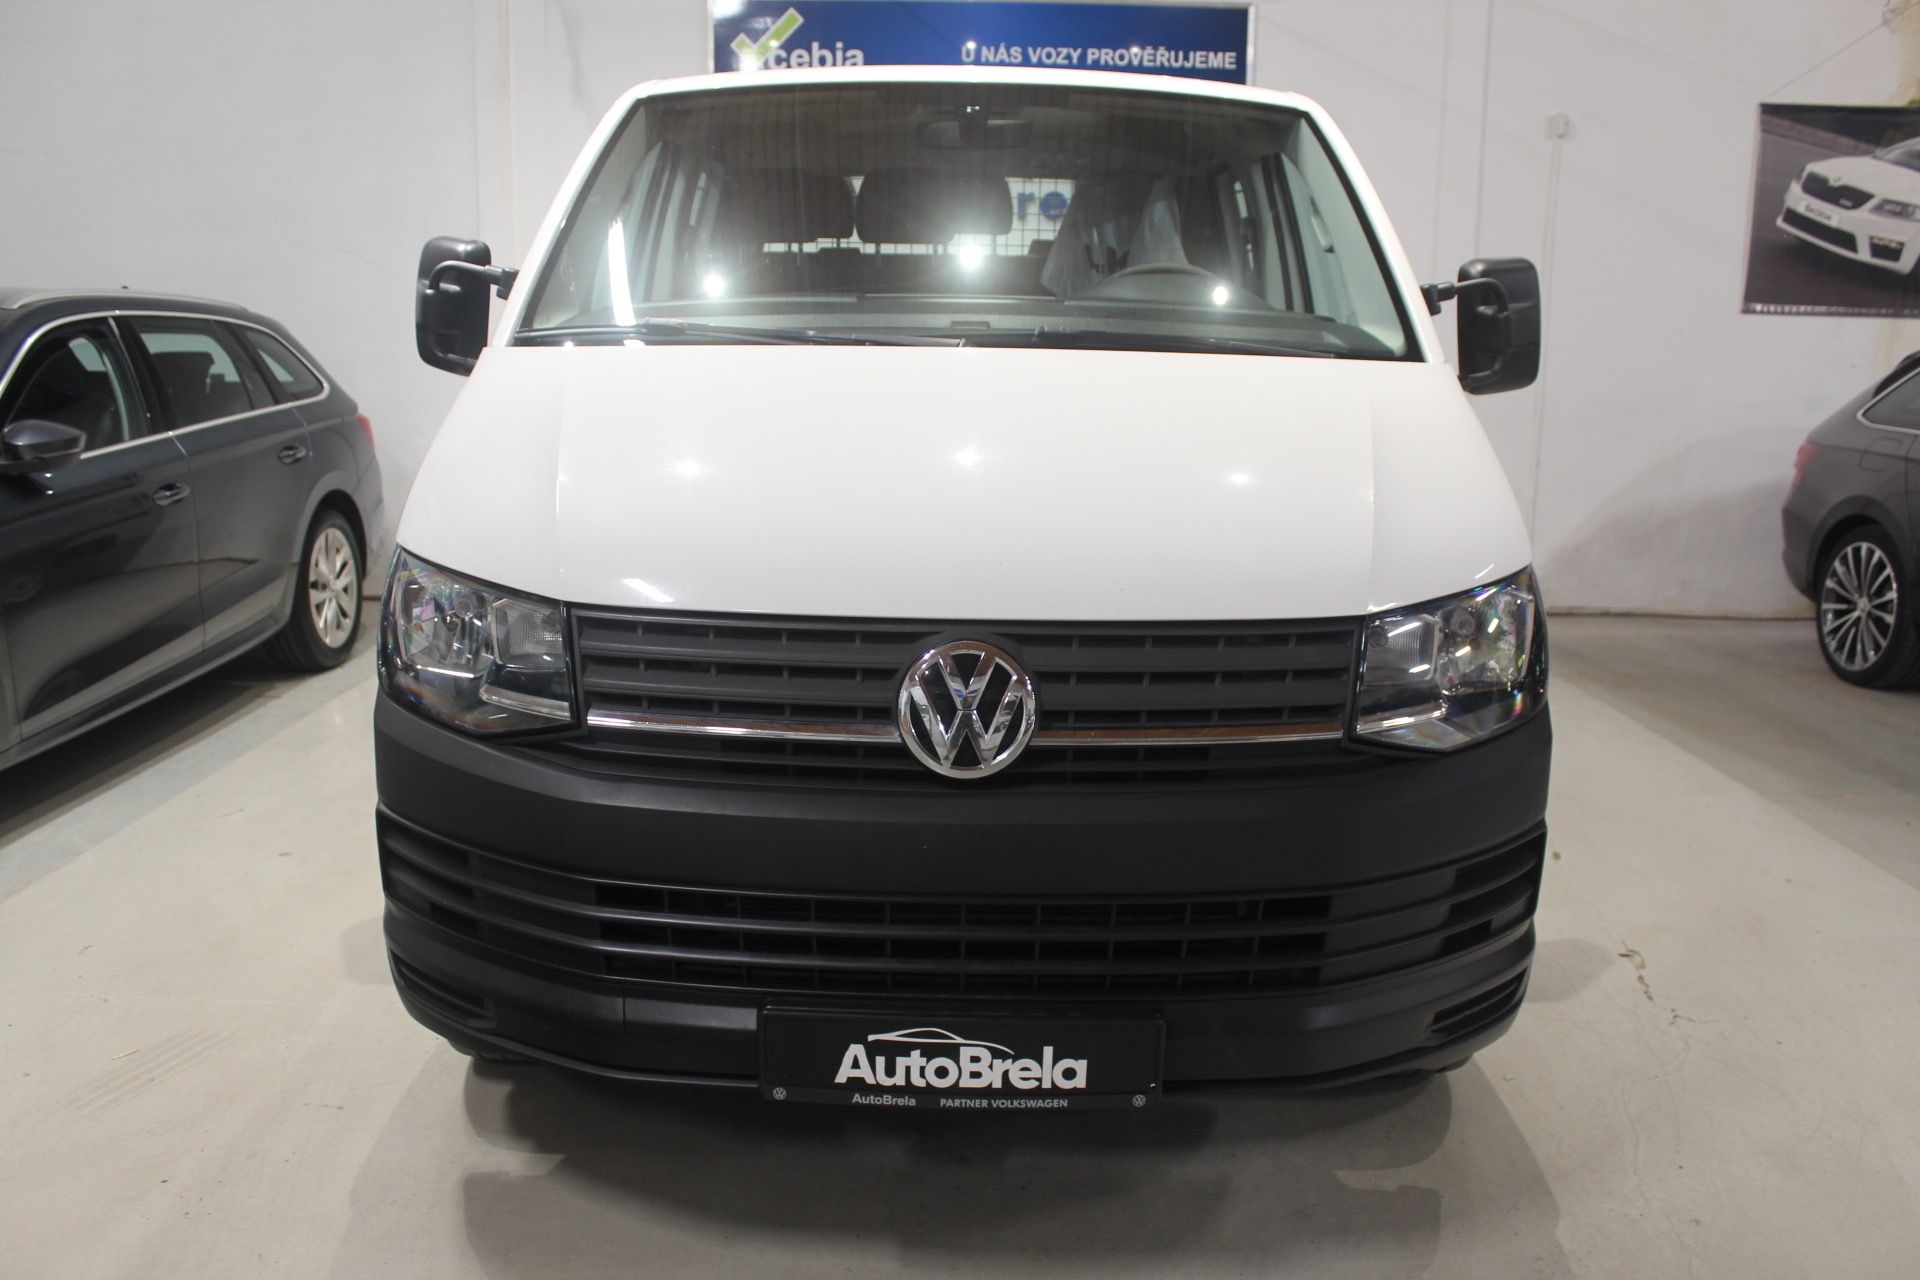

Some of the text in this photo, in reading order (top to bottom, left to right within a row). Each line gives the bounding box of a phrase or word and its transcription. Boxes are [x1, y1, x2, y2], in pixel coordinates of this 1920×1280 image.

[768, 41, 864, 69] cebia
[961, 43, 1237, 69] U NÁS VOZY PROVĚŘUJEME
[834, 1043, 1088, 1090] AutoBrela
[852, 1093, 916, 1107] AutoBrela
[940, 1099, 1068, 1109] PARTNER VOLKSWAGEN
